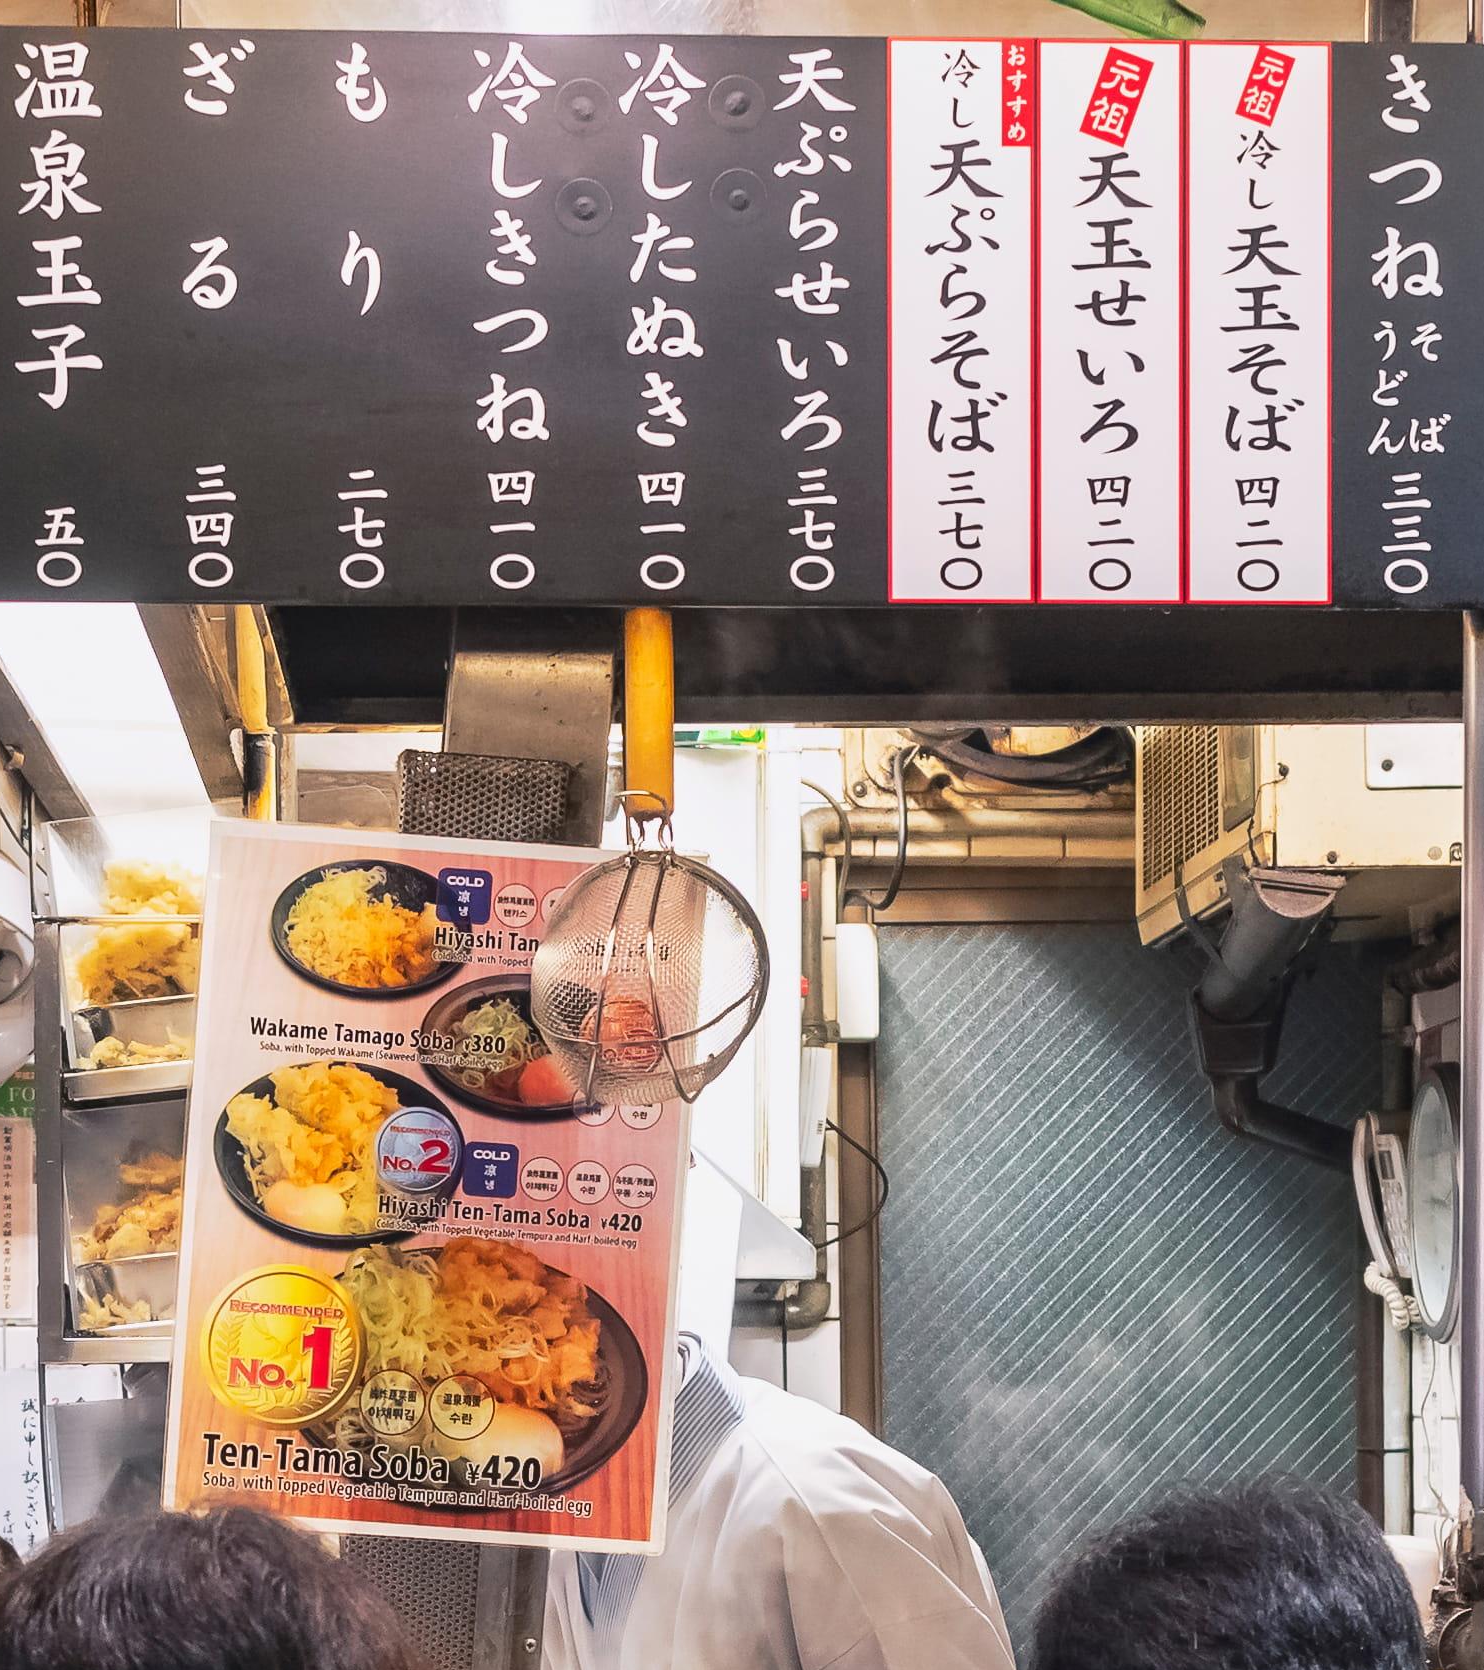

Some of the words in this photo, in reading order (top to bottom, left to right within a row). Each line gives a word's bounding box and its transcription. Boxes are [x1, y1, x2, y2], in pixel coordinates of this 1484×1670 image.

[1005, 43, 1028, 142] おすすめ
[1087, 57, 1144, 142] 元祖
[1241, 52, 1286, 123] 元祖
[14, 41, 103, 410] 温泉玉子
[182, 38, 256, 309] ざる
[335, 41, 387, 316] もり
[1368, 54, 1444, 300] きつね
[467, 37, 562, 443] 冷しきつね
[618, 43, 707, 447] 冷したぬき
[772, 48, 857, 452] 天ぷらせいろ
[923, 48, 1008, 454] 冷し天ぷらそば
[1220, 130, 1305, 452] 冷し天玉そば
[1071, 151, 1153, 454] 天玉せいろ
[34, 506, 85, 587] 五〇
[185, 464, 237, 588] 三四〇
[337, 469, 388, 589] 二七〇
[487, 470, 536, 589] 四一〇
[637, 471, 686, 590] 四一〇
[787, 468, 838, 591] 三七〇
[938, 470, 986, 591] 三七〇
[1086, 475, 1135, 592] 四二〇
[1235, 476, 1284, 592] 四二〇
[1381, 472, 1432, 594] 三三〇
[434, 926, 503, 951] Hiyashi
[446, 875, 485, 888] COLD
[498, 955, 529, 968] Topped
[250, 1017, 328, 1041] Wakame
[334, 1023, 405, 1050] Tamago
[410, 1029, 455, 1050] Soba
[464, 1035, 506, 1053] ¥380
[260, 1041, 281, 1052] Soba,
[284, 1042, 304, 1053] with
[306, 1044, 336, 1057] Topped
[337, 1046, 374, 1059] Wakame
[382, 1139, 451, 1174] No.2
[473, 1149, 511, 1161] COLD
[378, 1195, 447, 1219] Hiyashi
[452, 1200, 541, 1226] Ten-Tama
[546, 1208, 590, 1229] Soba
[601, 1213, 643, 1233] ¥420
[421, 1222, 440, 1233] with
[442, 1223, 472, 1236] Topped
[474, 1226, 515, 1239] Vegetable
[517, 1230, 553, 1242] Tempura
[554, 1232, 571, 1243] and
[621, 1239, 637, 1250] egg
[228, 1325, 338, 1391] No.1
[229, 1299, 344, 1319] RECOMMENDED
[203, 1433, 363, 1477] Ten-Tama
[370, 1445, 449, 1483] Soba
[467, 1454, 541, 1489] ¥420
[449, 1412, 473, 1426] 수란
[203, 1472, 238, 1489] Soba,
[243, 1475, 273, 1490] with
[277, 1477, 325, 1496] Topped
[328, 1480, 396, 1501] Vegetable
[398, 1484, 457, 1506] Tempura
[459, 1490, 487, 1506] and
[566, 1500, 593, 1518] egg
